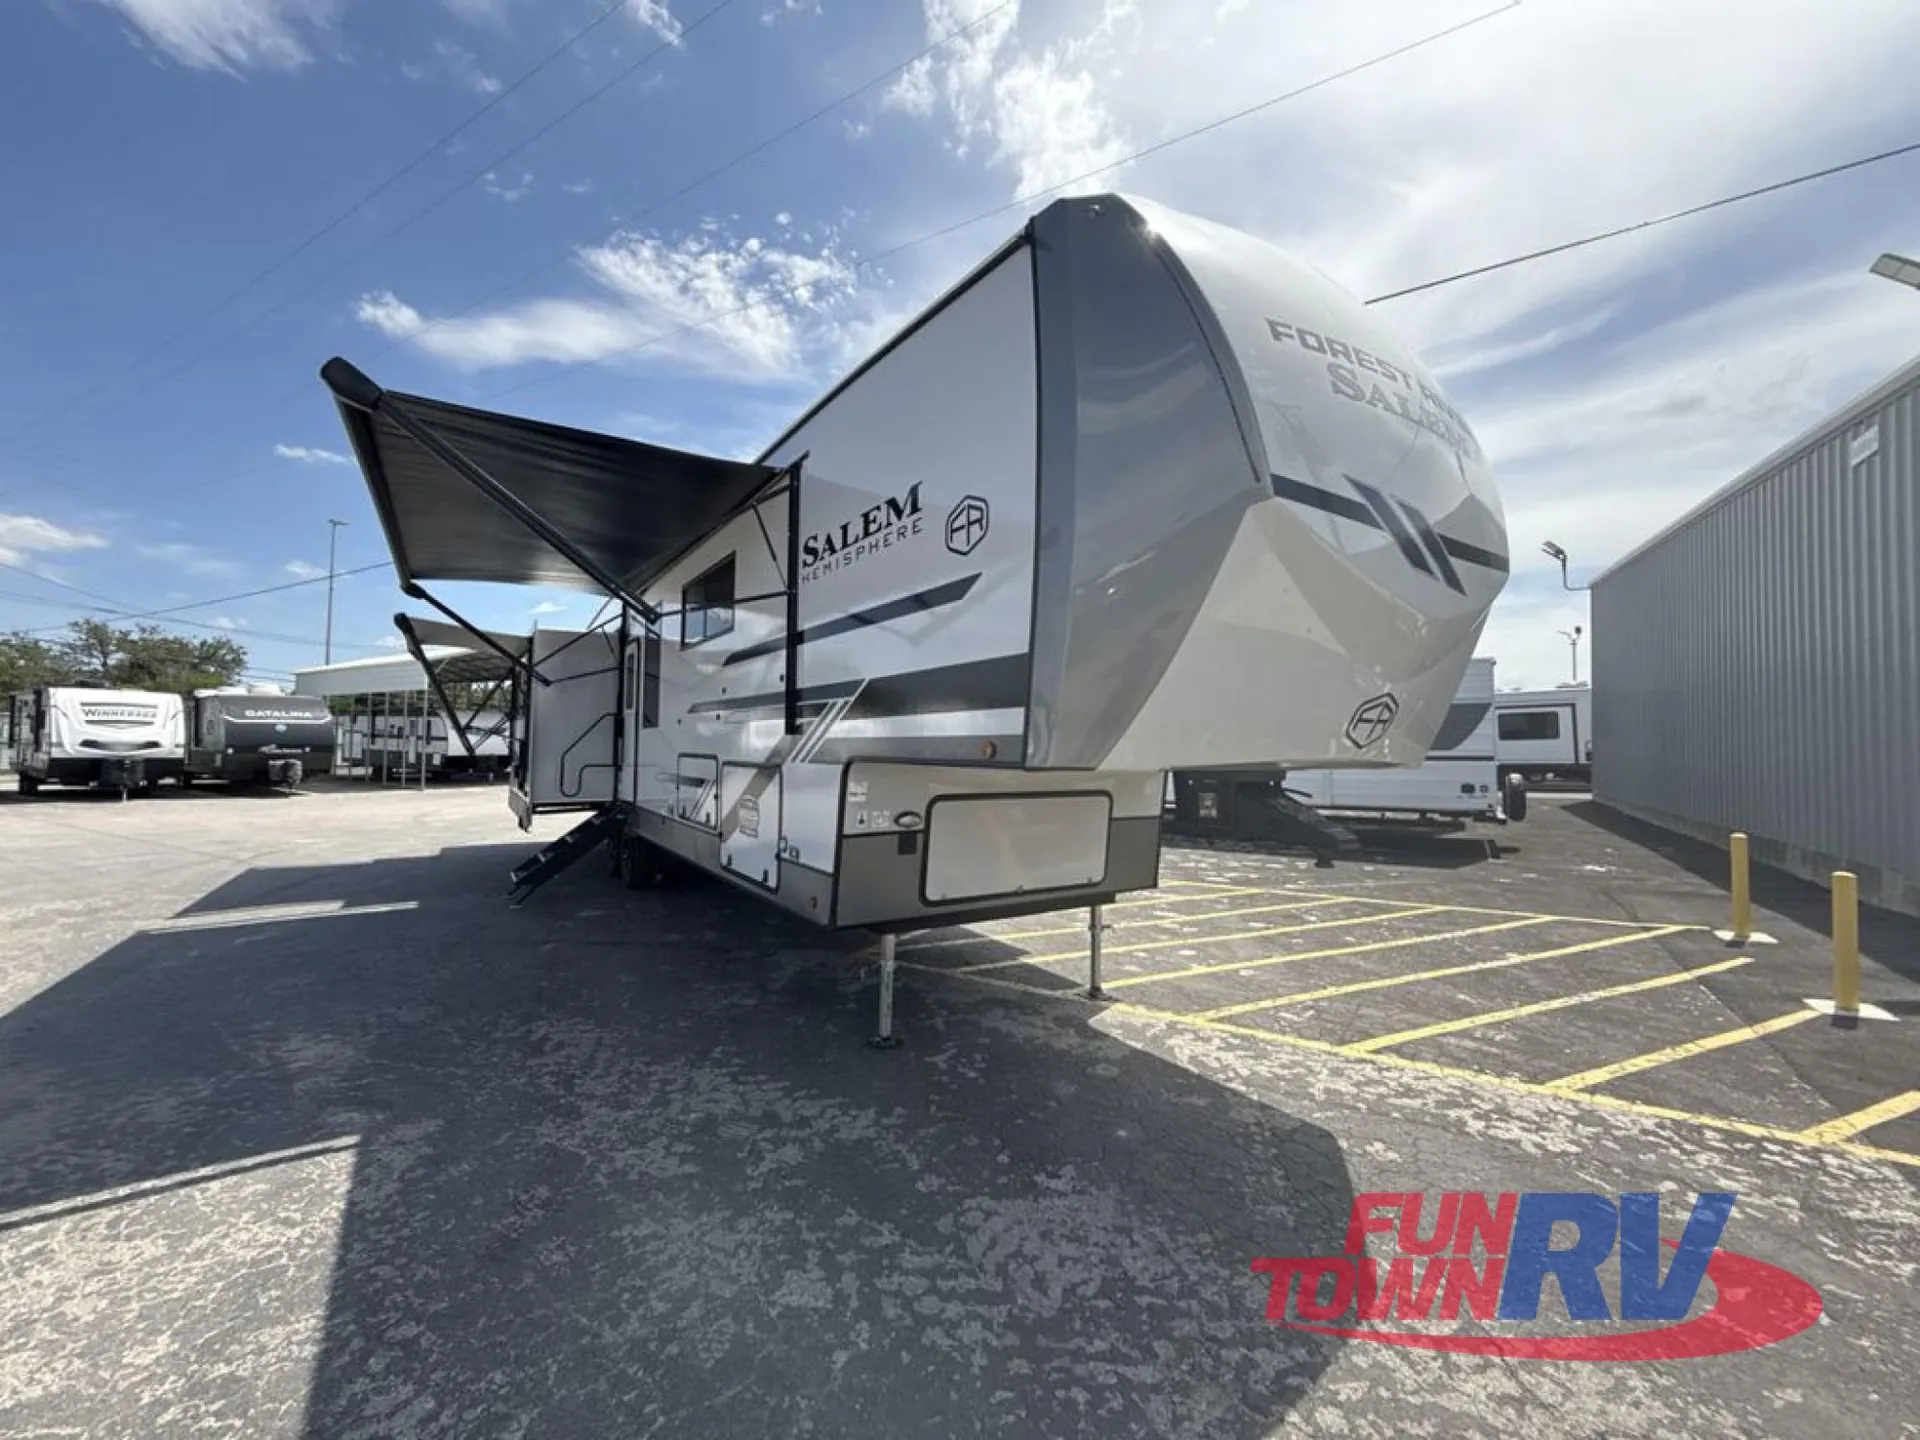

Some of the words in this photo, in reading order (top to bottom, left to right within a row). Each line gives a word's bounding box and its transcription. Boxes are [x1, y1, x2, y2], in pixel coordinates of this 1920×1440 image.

[1264, 316, 1413, 390] FOREST
[802, 480, 923, 569] SALEM
[802, 516, 923, 585] HEMISPHERE
